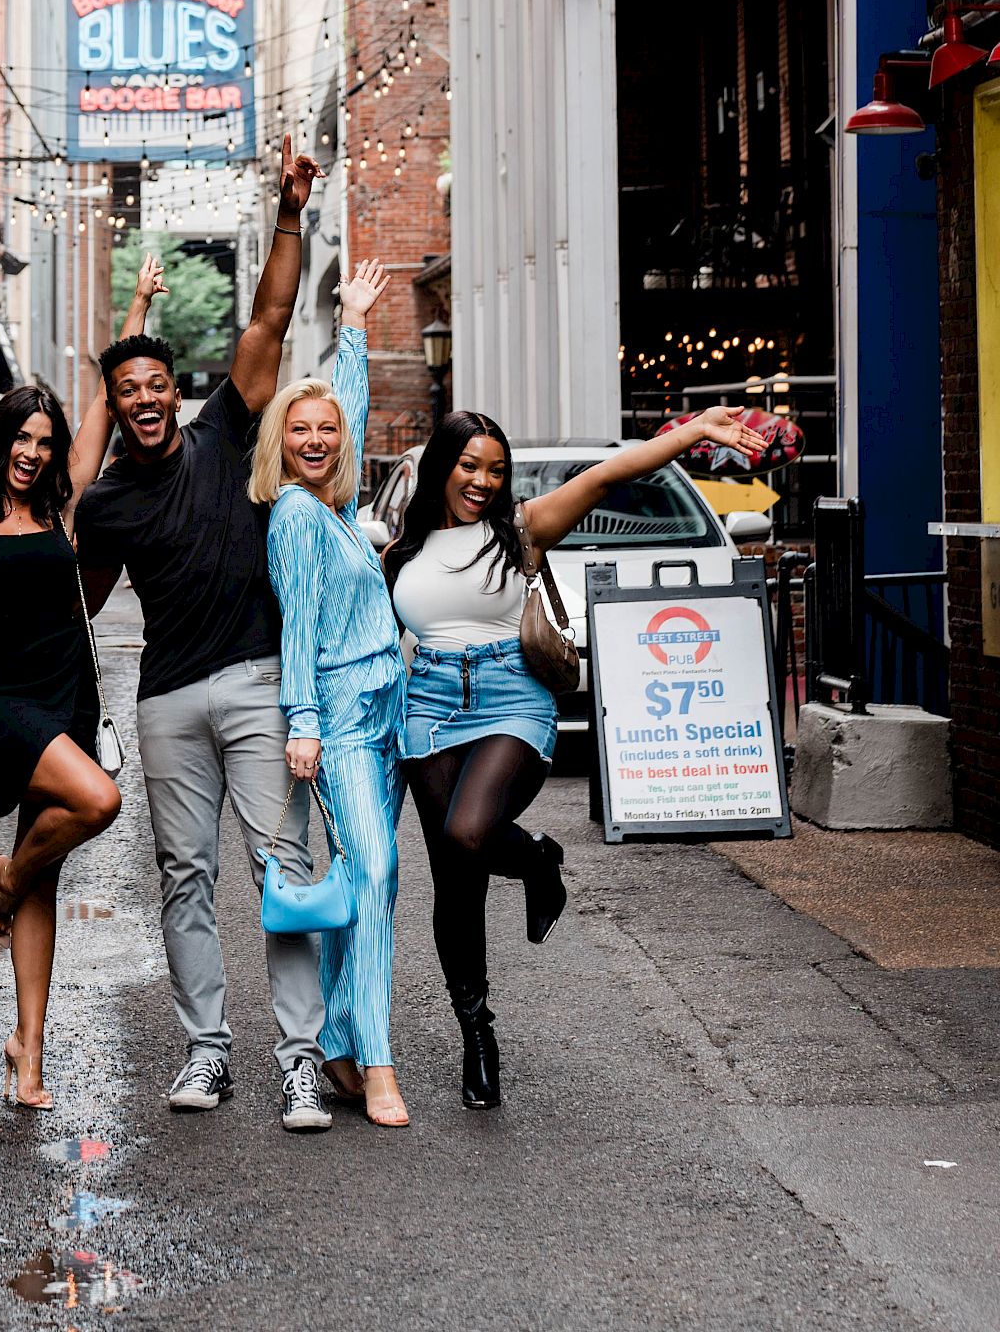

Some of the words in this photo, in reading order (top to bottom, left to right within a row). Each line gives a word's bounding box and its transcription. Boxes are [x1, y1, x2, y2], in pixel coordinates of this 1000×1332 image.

[80, 86, 182, 111] BOOGIE
[185, 85, 242, 111] BAR
[639, 633, 673, 644] FLEET
[676, 631, 718, 642] STREET
[668, 654, 695, 665] PUB
[615, 725, 679, 744] Lunch
[685, 721, 762, 744] Special
[620, 749, 679, 764] (includes
[683, 750, 691, 759] a
[695, 747, 720, 759] soft
[724, 745, 763, 758] drink)
[618, 768, 643, 780] The
[647, 766, 678, 779] best
[682, 764, 711, 777] deal
[716, 764, 729, 775] in
[733, 763, 769, 775] town
[647, 784, 666, 793] Yes,
[668, 785, 684, 794] you
[707, 783, 721, 792] get
[723, 782, 739, 790] our
[620, 797, 654, 805] famous
[656, 795, 677, 804] Fish
[679, 794, 696, 803] and
[698, 793, 724, 803] Chips
[726, 792, 739, 801] for
[624, 810, 661, 821] Monday
[664, 809, 673, 819] to
[675, 809, 707, 820] Friday,
[710, 808, 735, 817] 11am
[738, 807, 747, 815] to
[750, 806, 771, 816] 2pm
